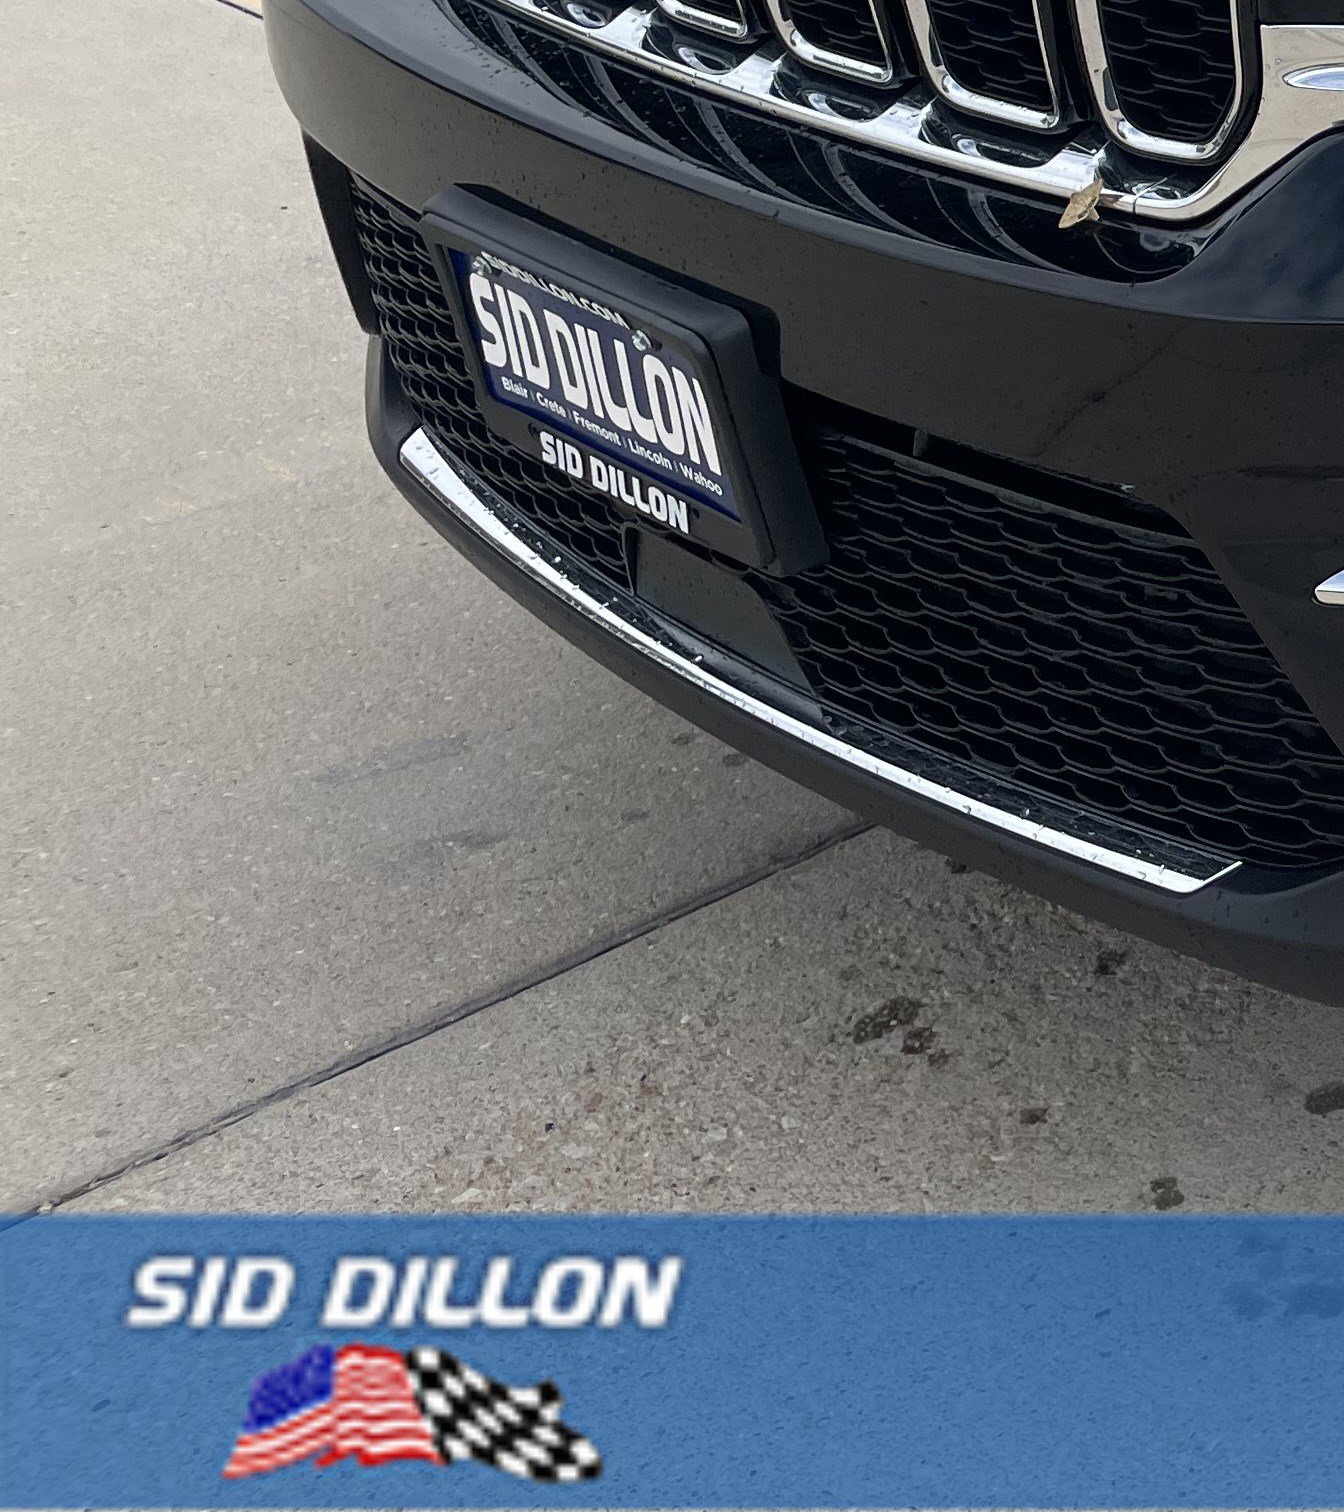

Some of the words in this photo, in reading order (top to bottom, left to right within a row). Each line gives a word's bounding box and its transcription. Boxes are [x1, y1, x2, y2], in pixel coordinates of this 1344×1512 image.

[469, 272, 551, 390] SID
[542, 308, 723, 477] DILLON
[501, 375, 529, 399] Blair
[535, 391, 567, 418] Crete
[571, 409, 623, 447] Fremont
[627, 437, 673, 471] Lincoln
[679, 461, 724, 497] Wahoo
[539, 430, 584, 479] SID
[589, 454, 690, 535] DILLON
